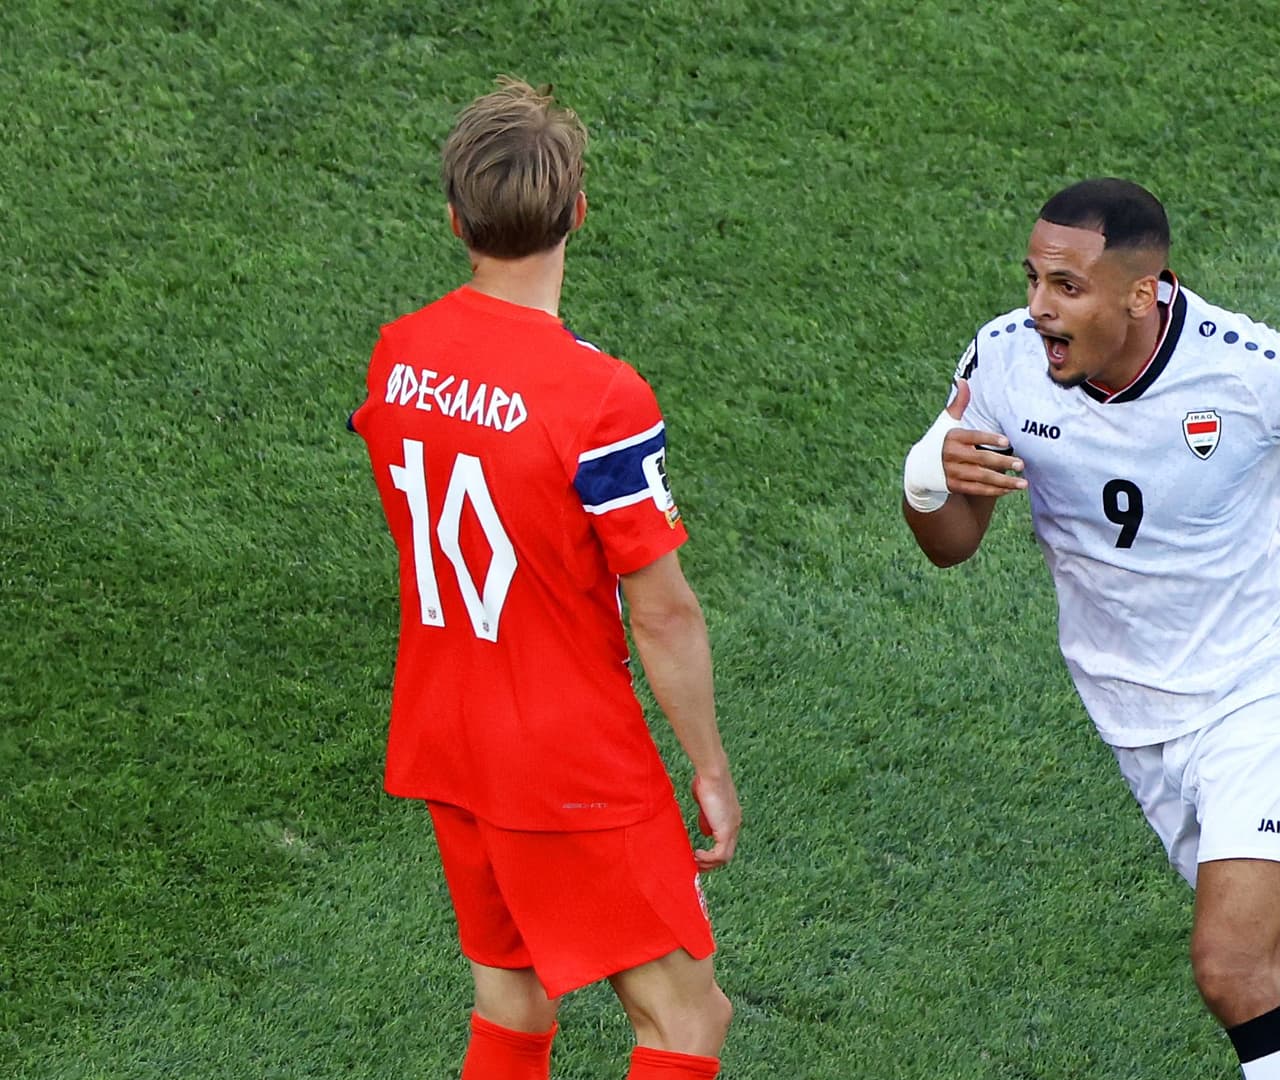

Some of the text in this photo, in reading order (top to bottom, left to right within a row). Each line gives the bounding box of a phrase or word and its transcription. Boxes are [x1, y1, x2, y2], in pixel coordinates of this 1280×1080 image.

[385, 363, 528, 433] ØDEGAARD
[1021, 419, 1061, 440] JAKO
[388, 438, 518, 643] 10
[1103, 478, 1144, 549] 9
